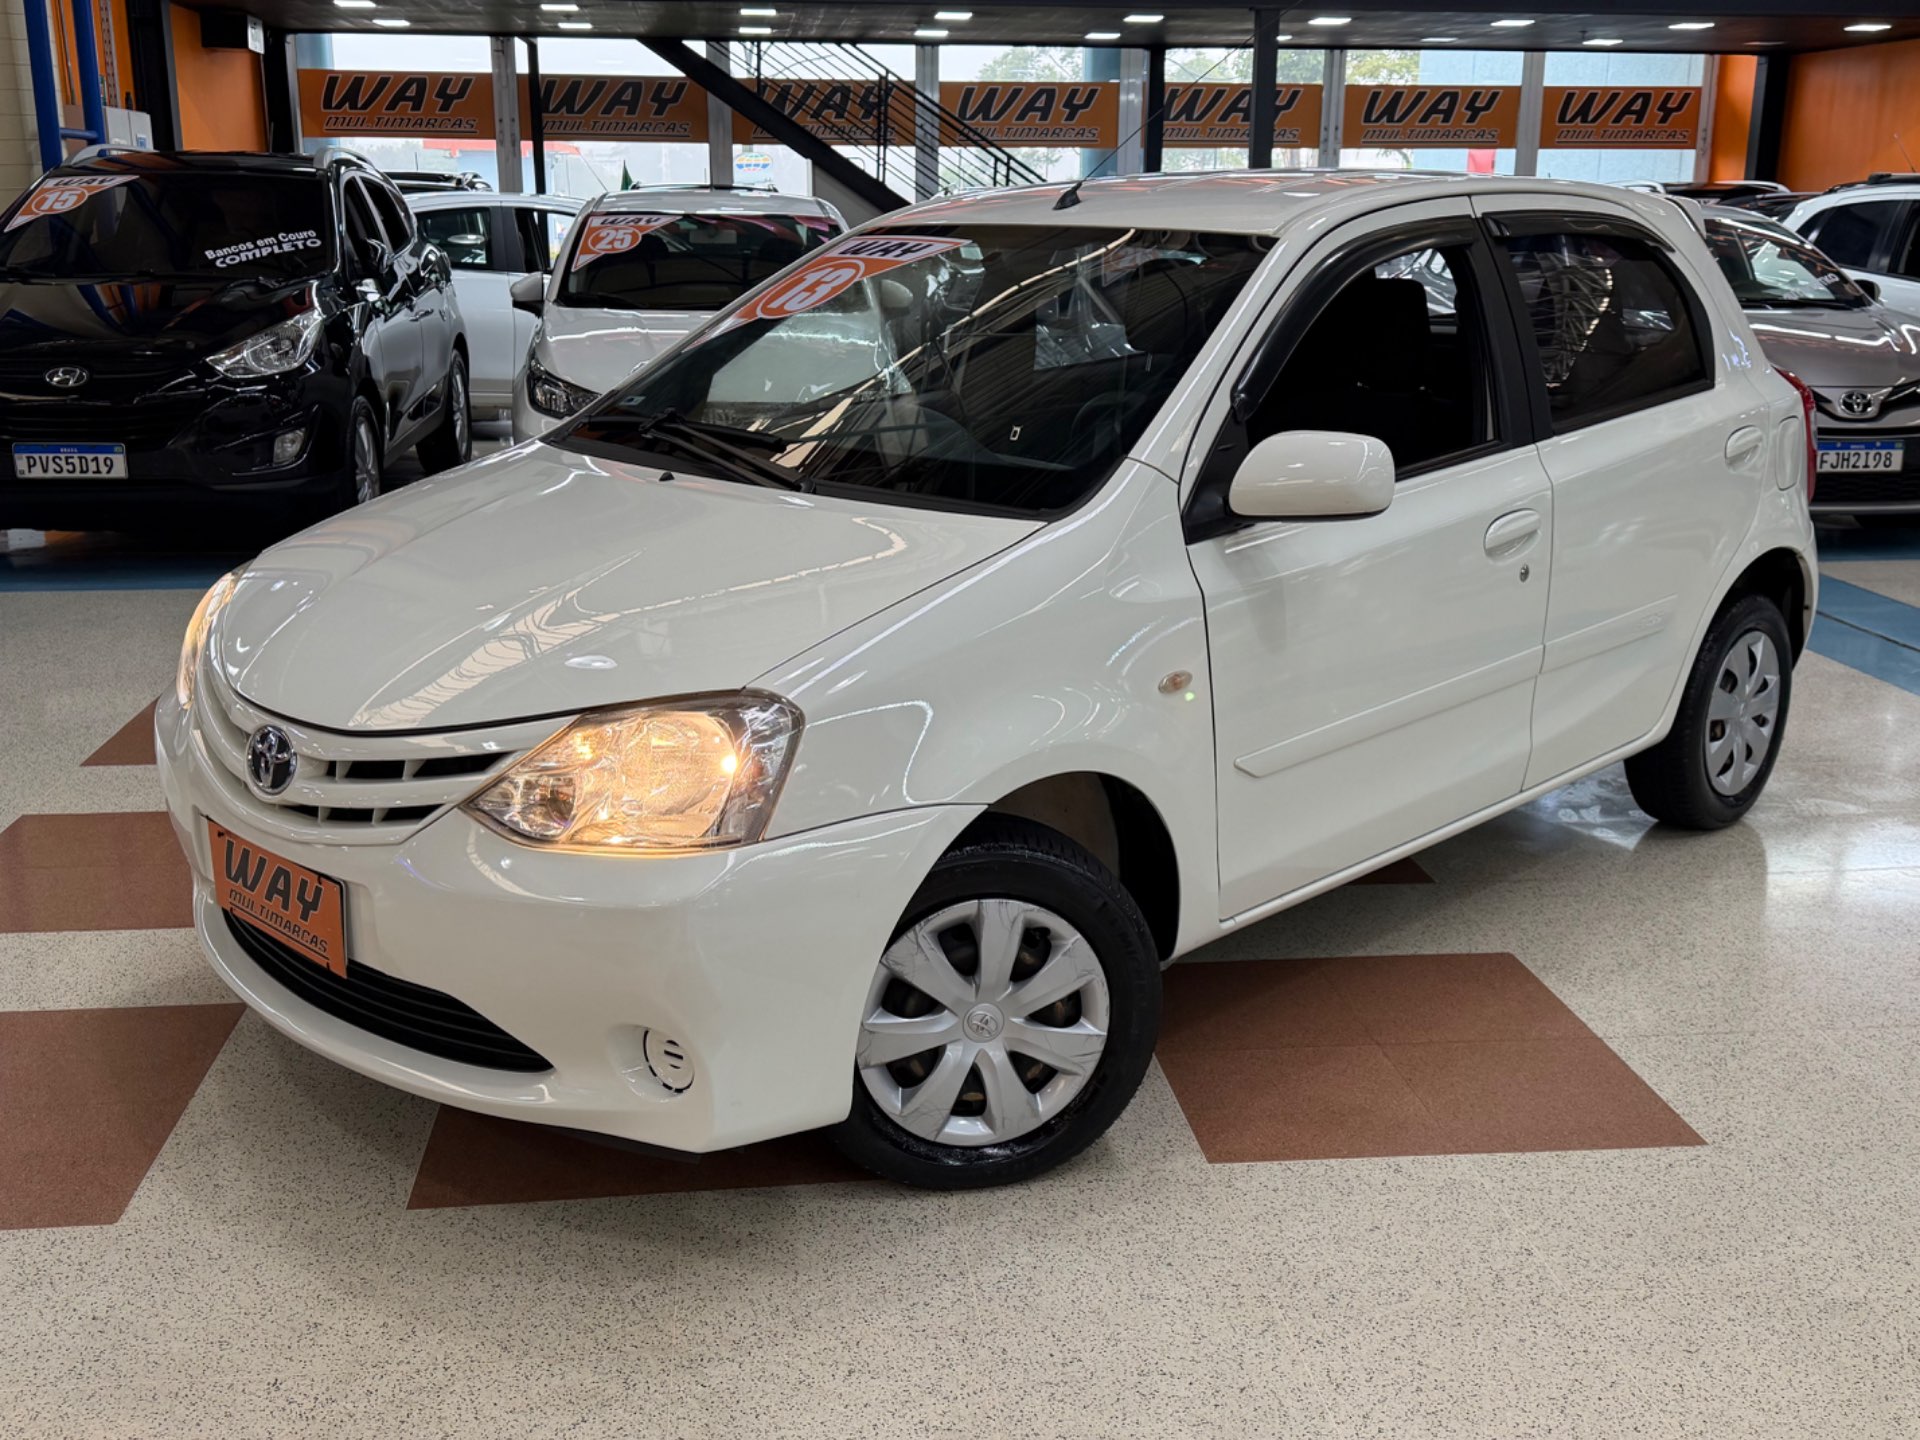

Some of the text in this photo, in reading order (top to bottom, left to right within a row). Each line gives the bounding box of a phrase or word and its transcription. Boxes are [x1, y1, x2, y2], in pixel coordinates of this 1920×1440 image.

[321, 74, 476, 113] WAY
[541, 78, 689, 117] WAY
[957, 85, 1102, 124] WAY
[1361, 88, 1502, 126] WAY
[1556, 89, 1694, 126] WAY
[324, 115, 478, 130] MULTIMARCAS
[543, 119, 690, 133] MULTIMARCAS
[1362, 127, 1499, 140] MULTIMARCAS
[1557, 128, 1691, 141] MULTIMARCAS
[40, 190, 82, 211] 15
[204, 229, 317, 260] Bancos em Couro
[215, 238, 322, 268] COMPLETO
[595, 229, 633, 250] 25
[838, 240, 933, 258] WAY
[766, 267, 857, 312] 13
[25, 455, 114, 475] PVS5D19
[1819, 451, 1893, 470] FJH2I98
[225, 838, 325, 924] WAY
[229, 888, 329, 954] MULTIMARCAS
